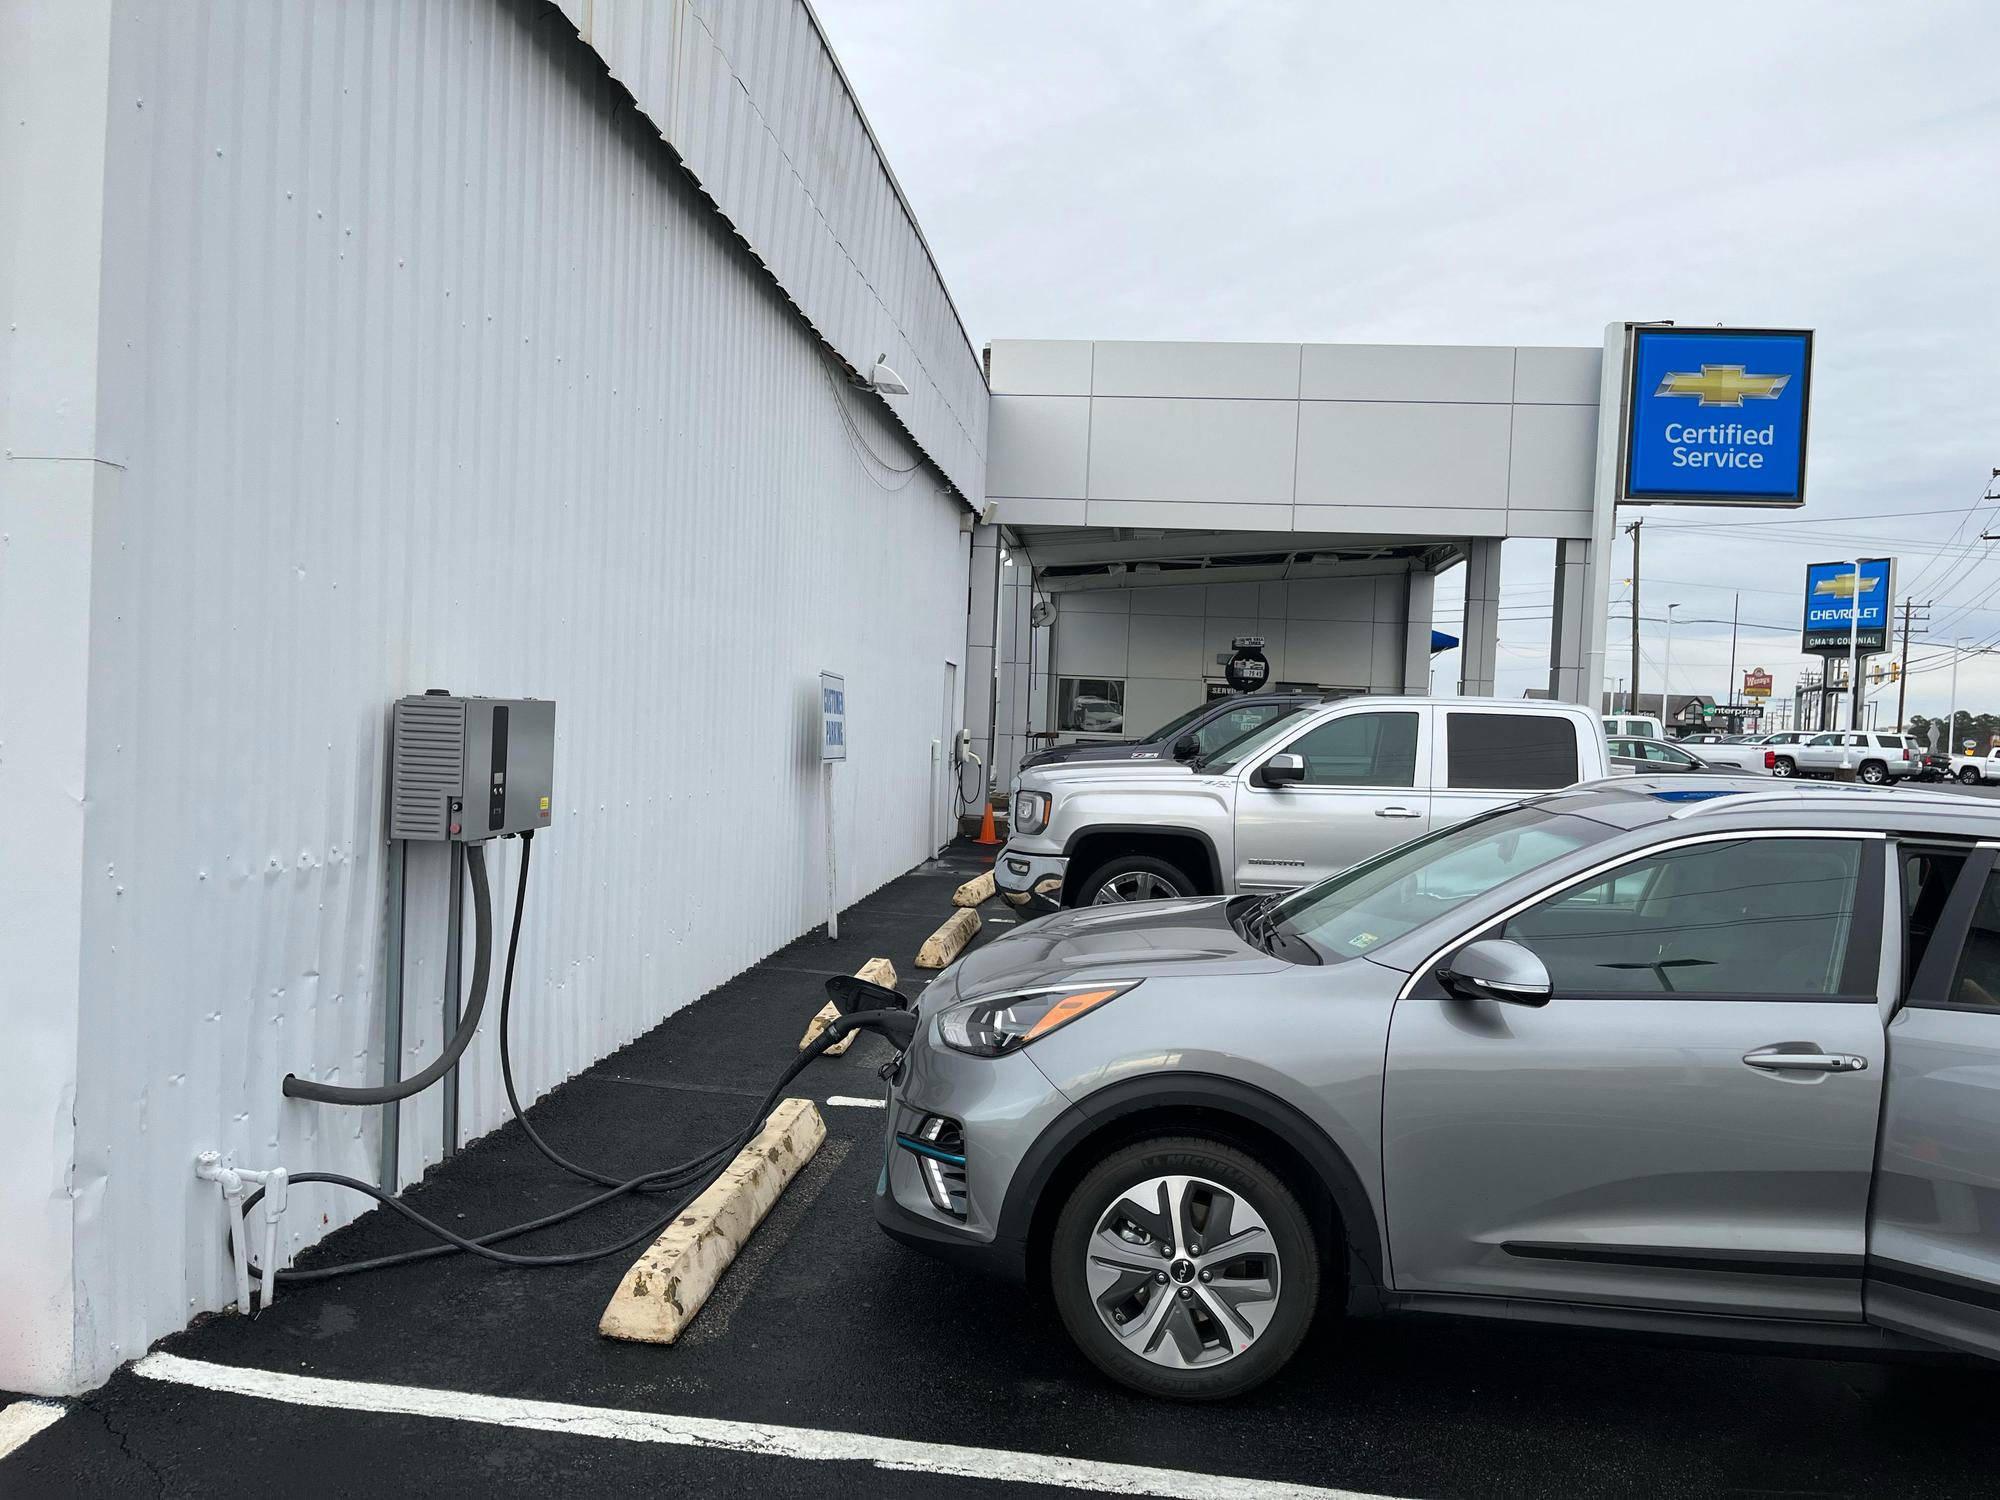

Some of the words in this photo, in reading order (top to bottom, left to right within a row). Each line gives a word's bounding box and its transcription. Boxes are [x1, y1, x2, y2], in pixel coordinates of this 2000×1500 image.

[1665, 423, 1774, 446] Certified
[1672, 447, 1764, 469] Service
[1809, 638, 1834, 646] CMA'S
[1837, 636, 1877, 645] COLNIAL
[1704, 707, 1761, 716] enterprise
[1167, 1154, 1257, 1189] MICHELIN
